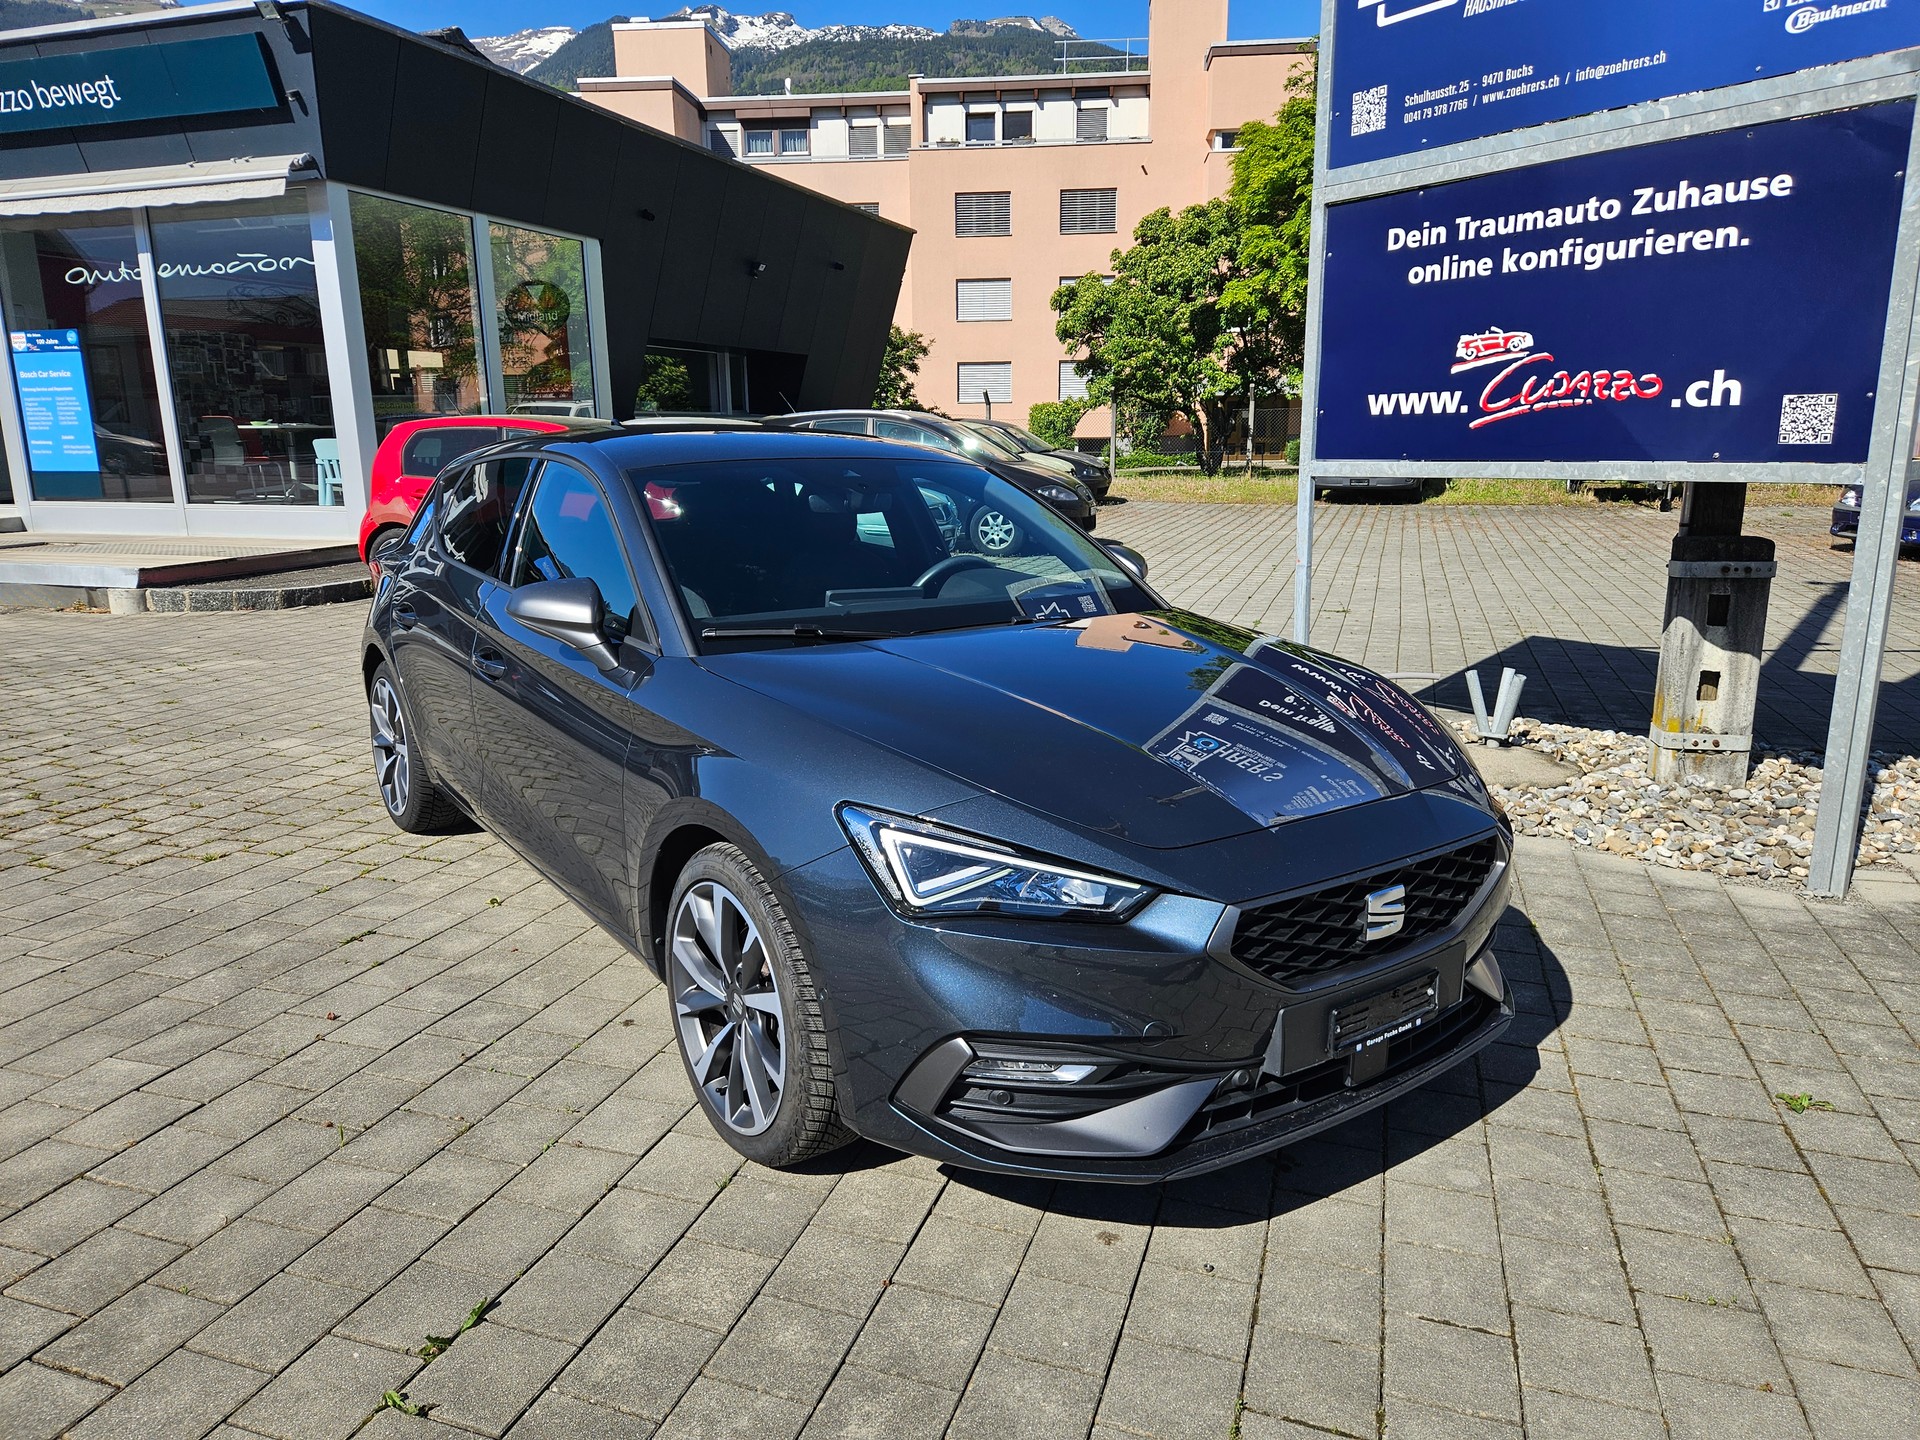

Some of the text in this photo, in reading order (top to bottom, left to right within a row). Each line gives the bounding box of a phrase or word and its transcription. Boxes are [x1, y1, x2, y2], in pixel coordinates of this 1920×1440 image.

[1786, 0, 1888, 33] Bauknecht
[31, 74, 122, 109] bewegt
[1403, 109, 1421, 124] 0041
[1422, 107, 1432, 119] 79
[1433, 103, 1448, 117] 378
[1449, 98, 1468, 113] 7766
[1482, 74, 1560, 104] www.zoehrers.ch
[1575, 50, 1667, 82] info@zoehrers.ch
[1404, 84, 1457, 107] Schulhausstr.
[1459, 80, 1470, 93] 25
[1482, 71, 1504, 87] 9470
[1506, 64, 1534, 81] Buchs
[1387, 172, 1794, 251] Dein Traumauto Zuhause
[1407, 225, 1751, 285] online konfigurieren.
[19, 369, 72, 379] Bosch Car Service
